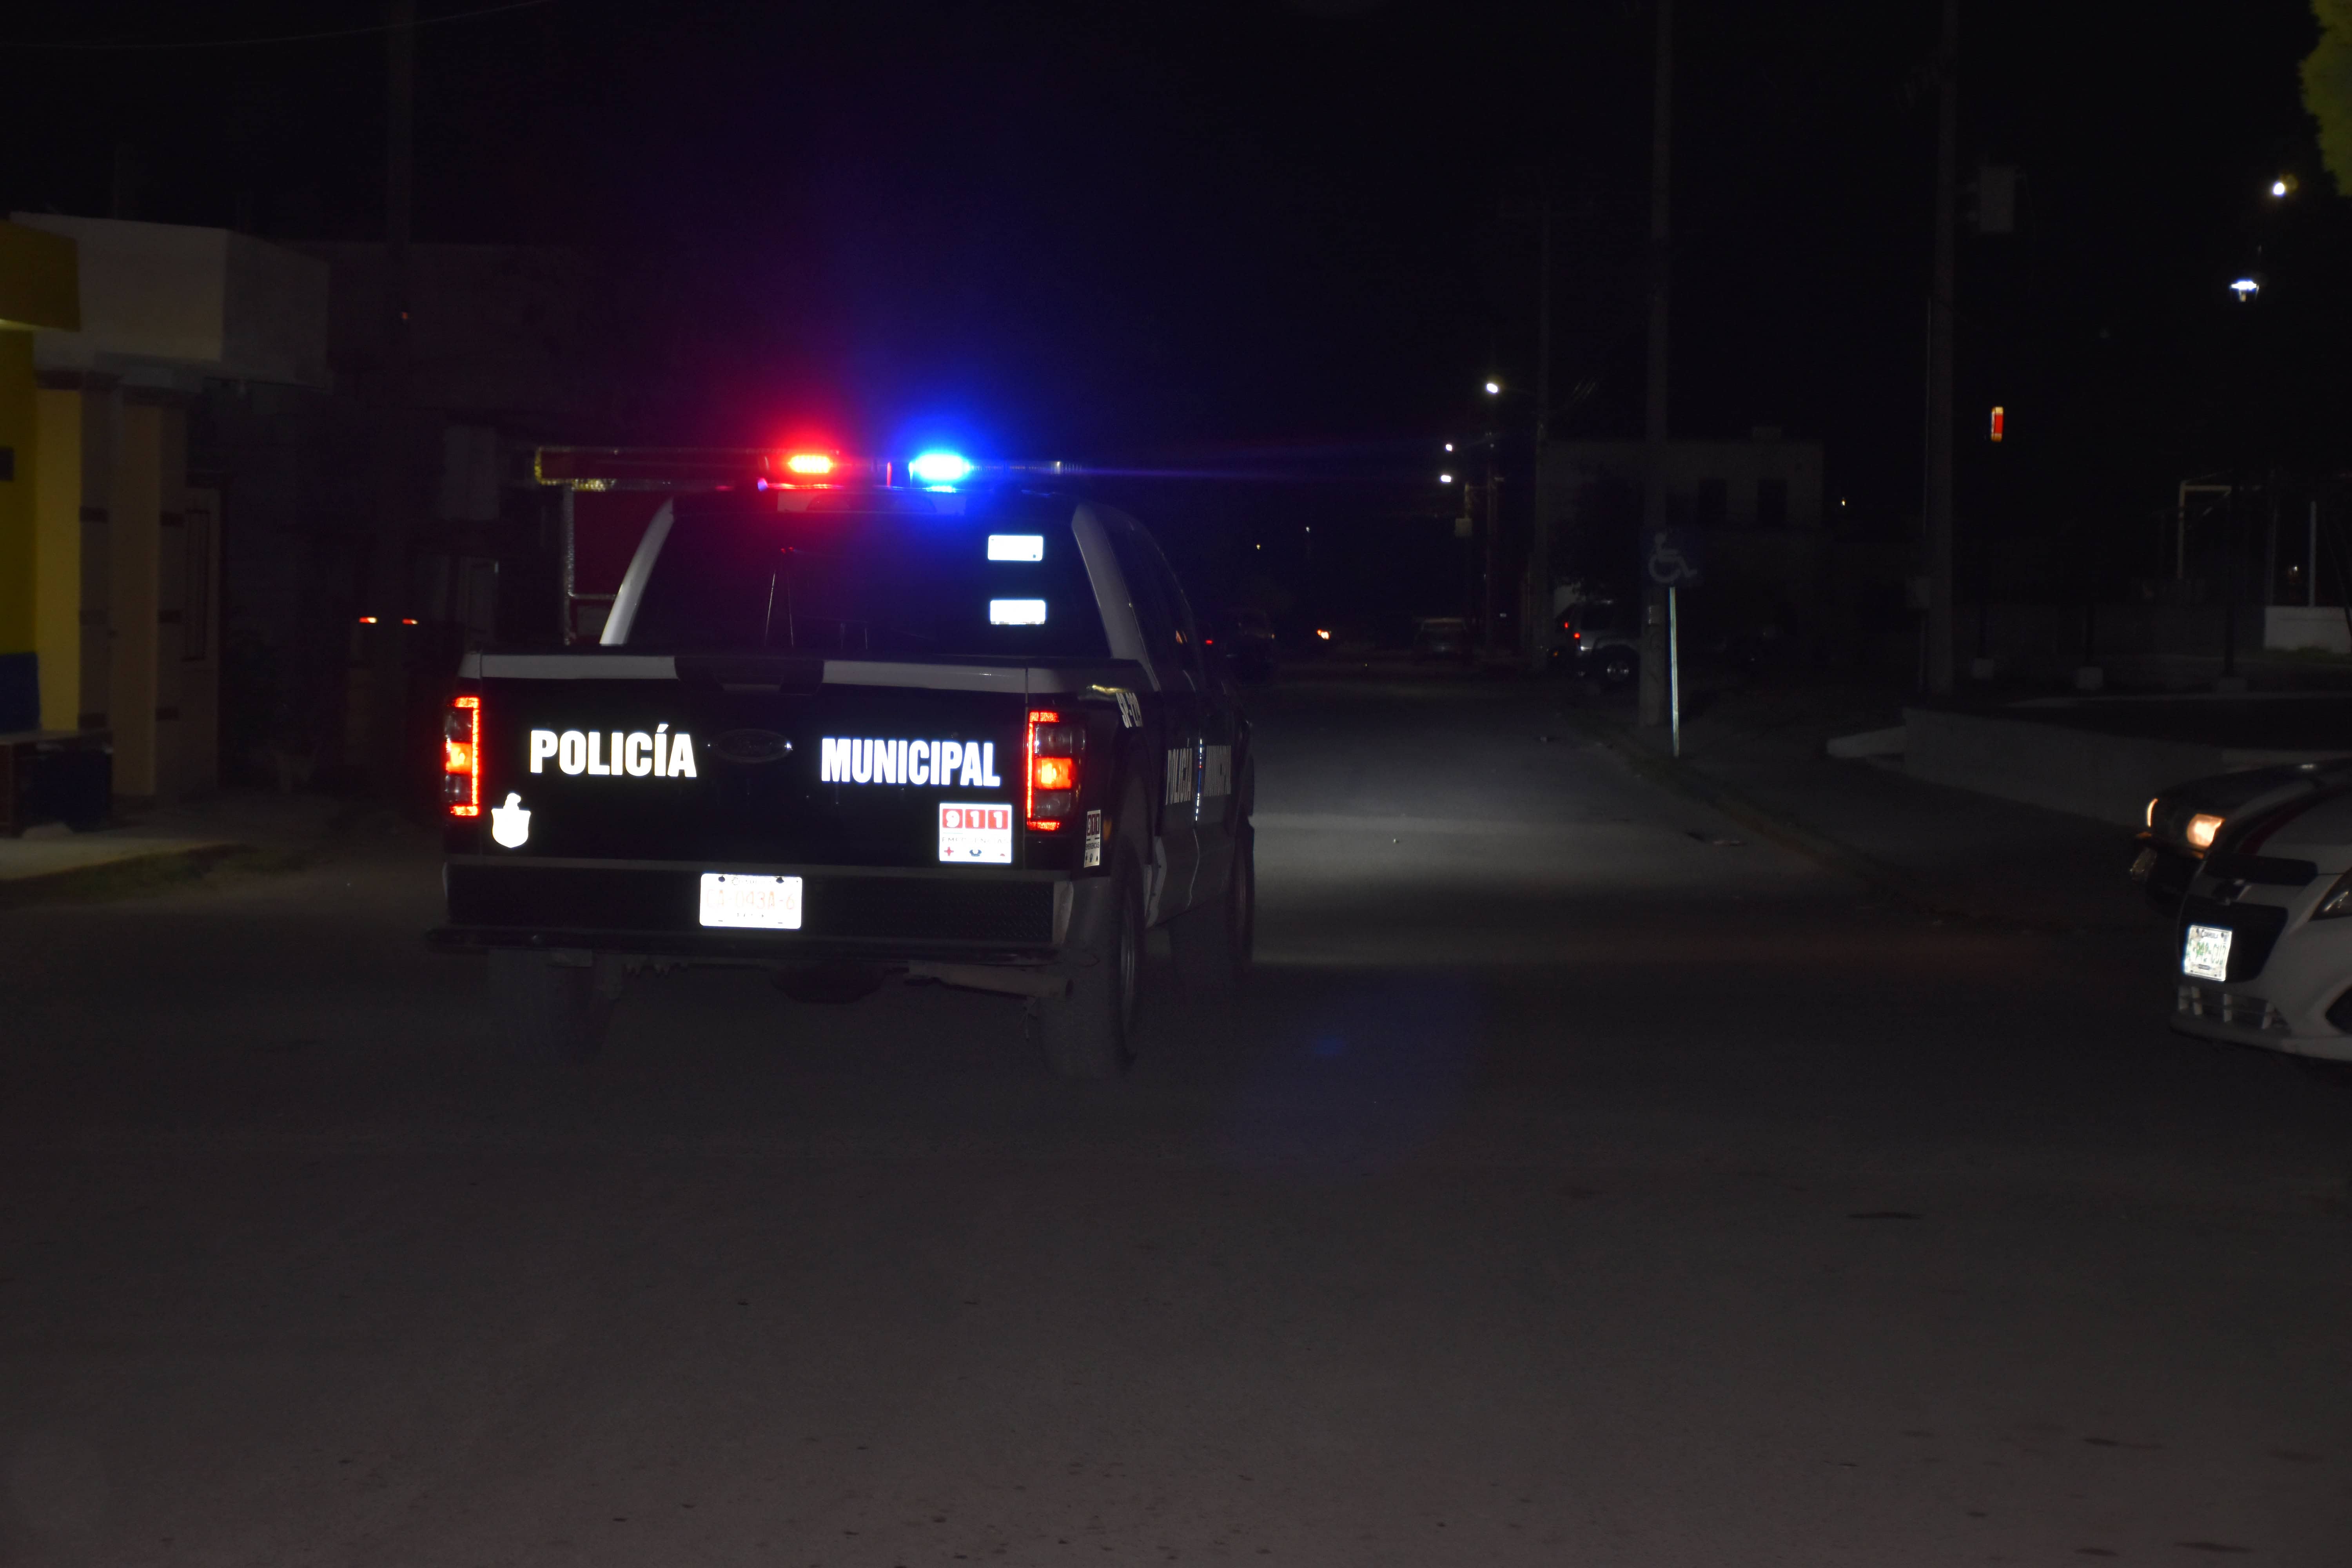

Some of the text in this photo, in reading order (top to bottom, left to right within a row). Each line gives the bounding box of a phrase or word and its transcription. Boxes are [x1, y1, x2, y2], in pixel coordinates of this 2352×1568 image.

[530, 723, 1000, 787] POLICÍA MUNICIPAL
[944, 810, 1004, 829] 911
[1087, 815, 1100, 834] 911
